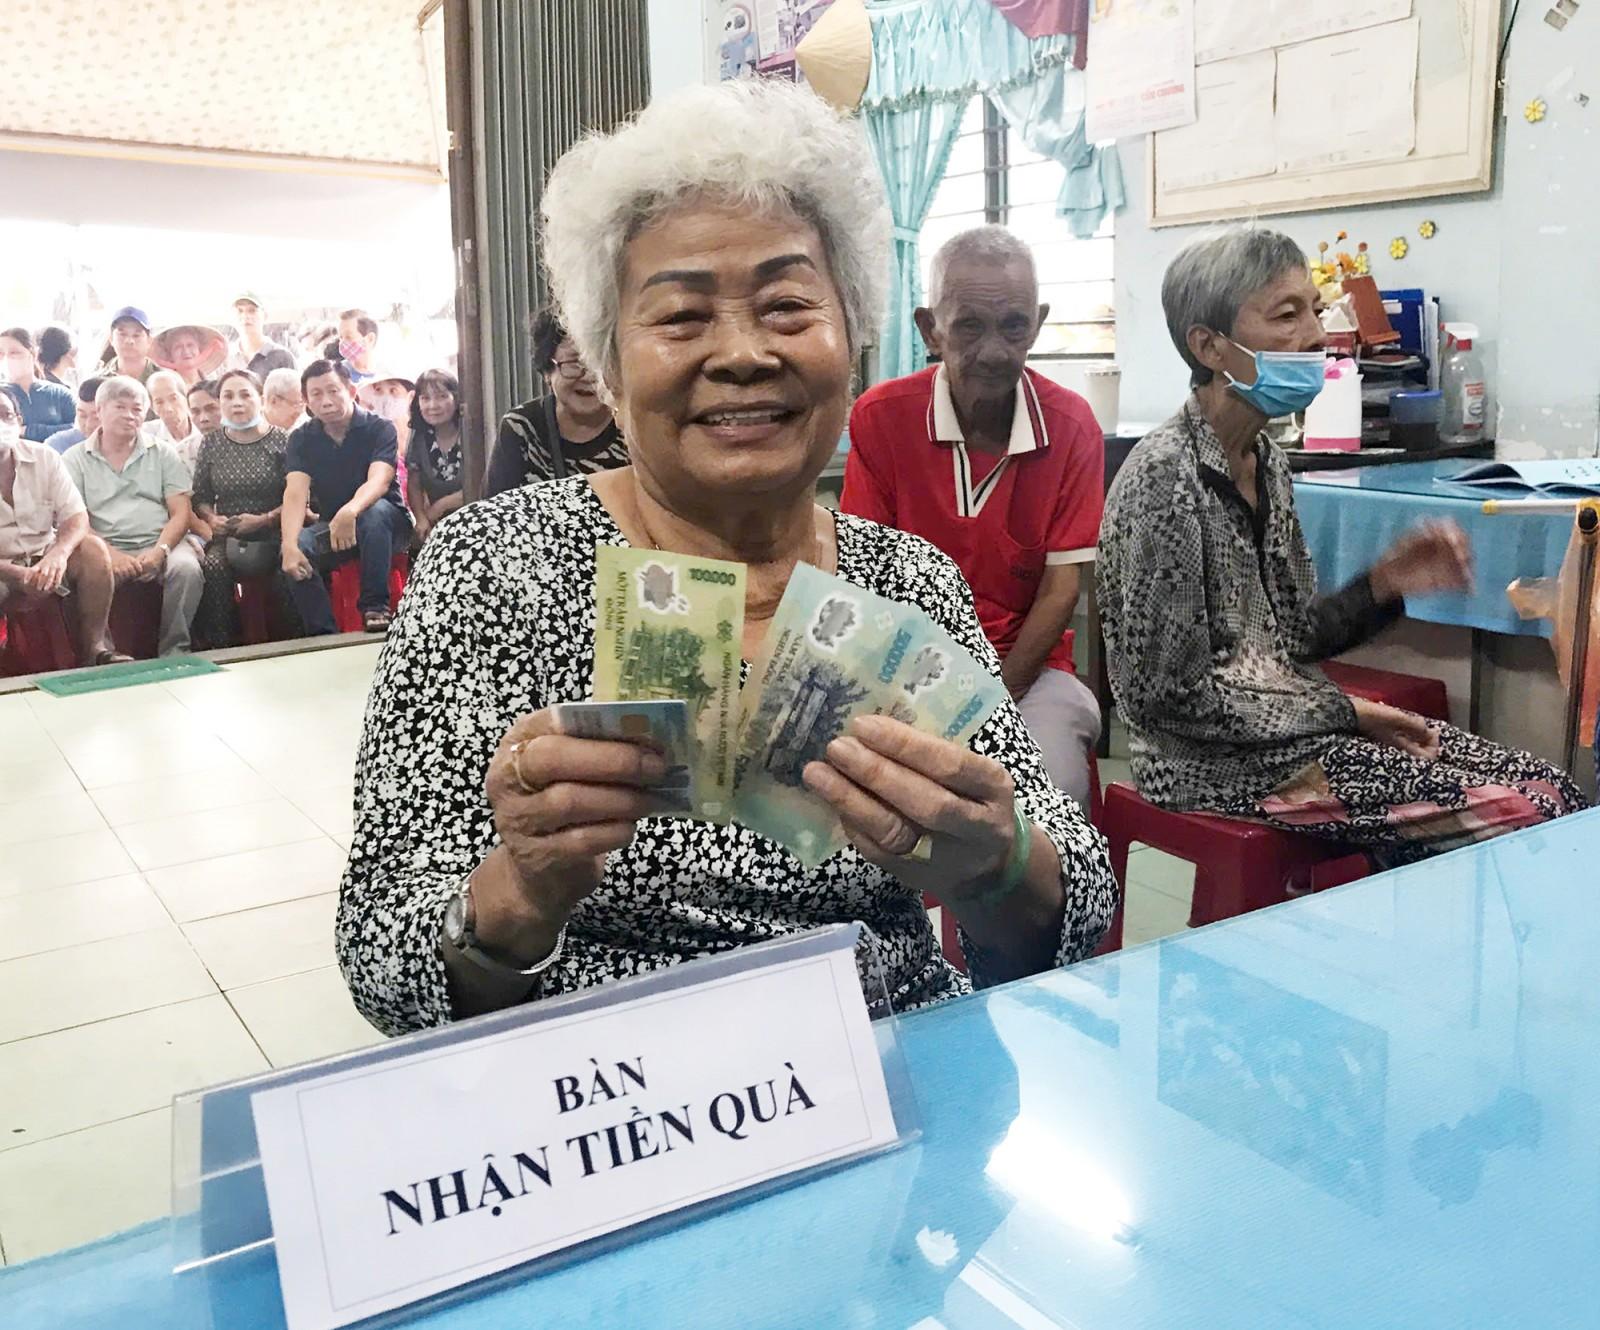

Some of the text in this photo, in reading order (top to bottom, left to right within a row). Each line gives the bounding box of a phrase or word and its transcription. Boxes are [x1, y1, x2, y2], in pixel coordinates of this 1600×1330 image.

[688, 567, 736, 586] 100000
[552, 1056, 647, 1114] BÀN
[380, 1062, 816, 1236] NHẬN TIỀN QUÀ
